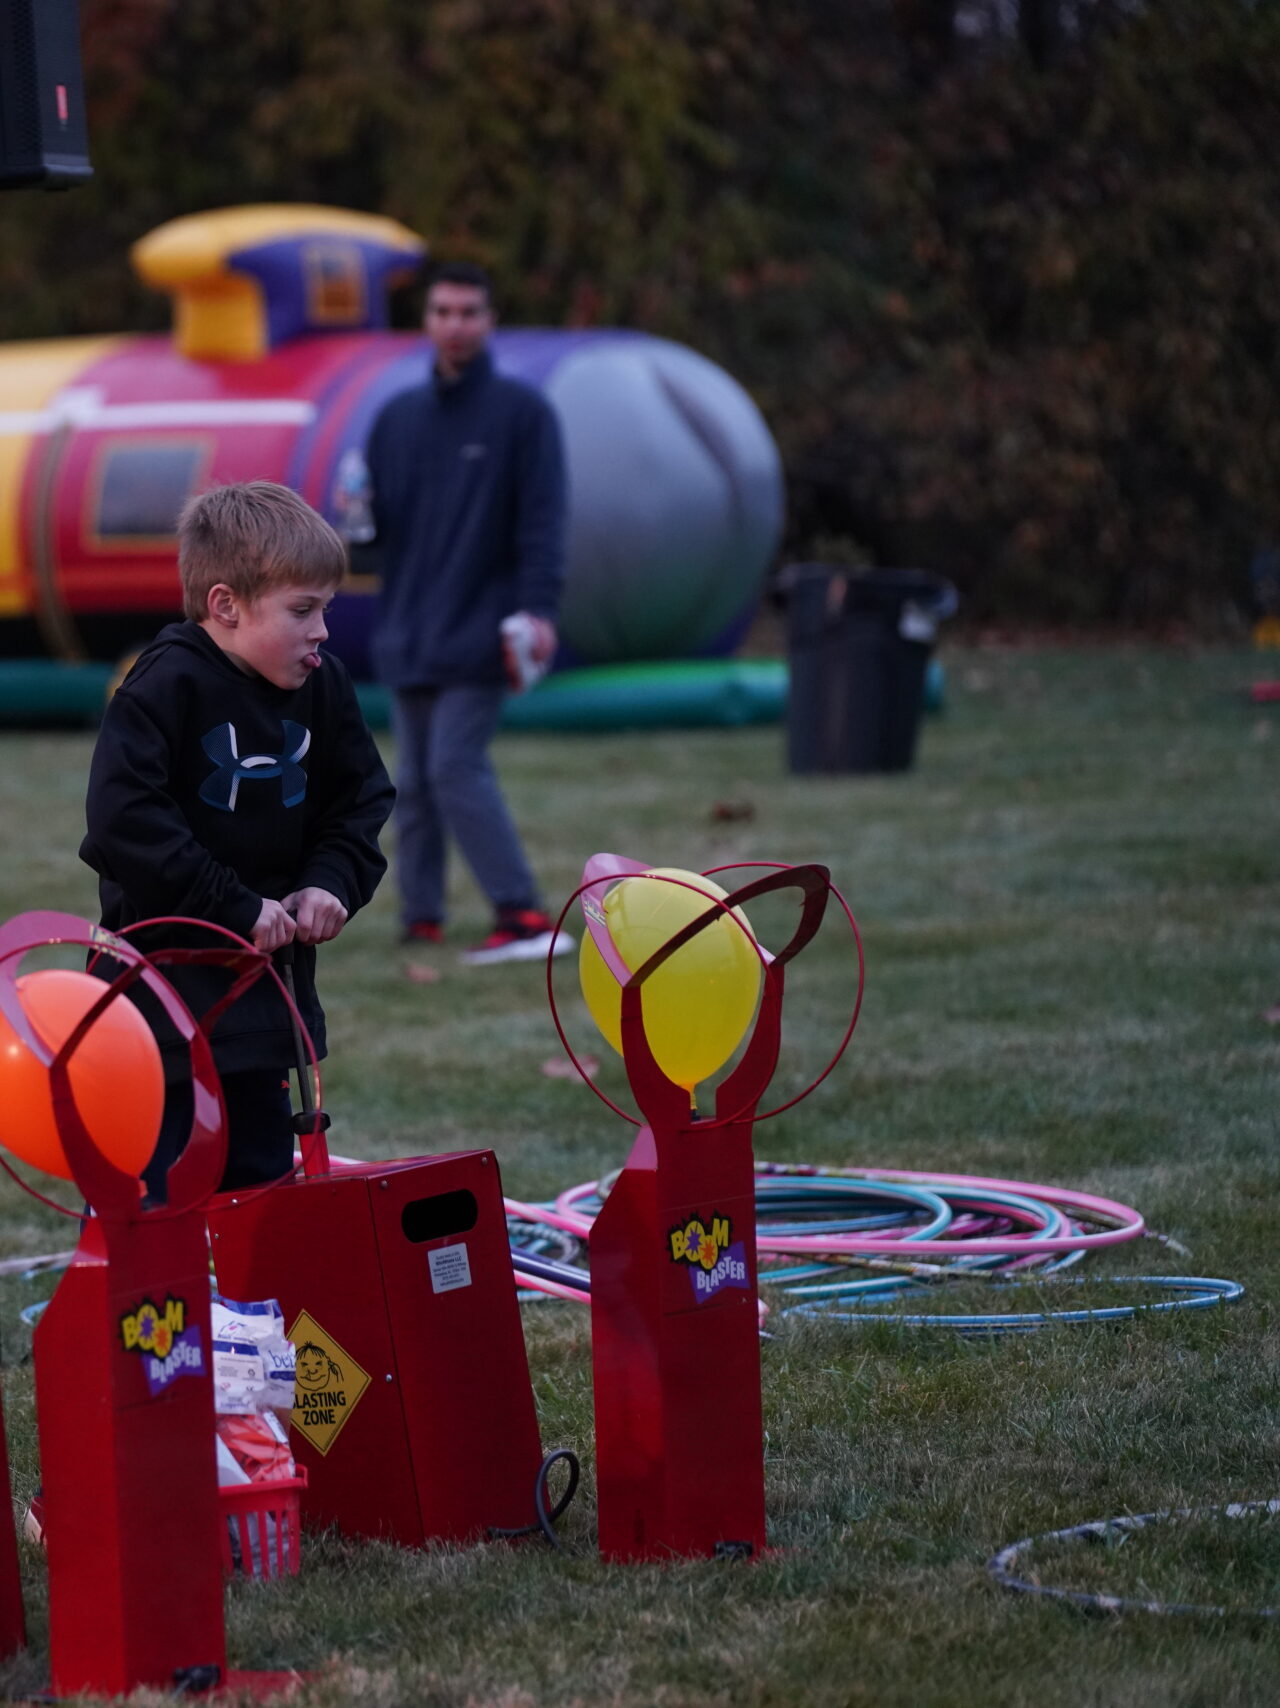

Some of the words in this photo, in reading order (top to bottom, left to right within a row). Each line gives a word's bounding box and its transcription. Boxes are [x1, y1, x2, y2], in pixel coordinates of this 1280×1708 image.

[670, 1217, 729, 1270] BOOM
[696, 1256, 746, 1293] BLASTER
[122, 1299, 184, 1359] BOOM
[149, 1340, 202, 1384] BLASTER
[293, 1390, 346, 1409] LASTING
[302, 1409, 336, 1426] ZONE
